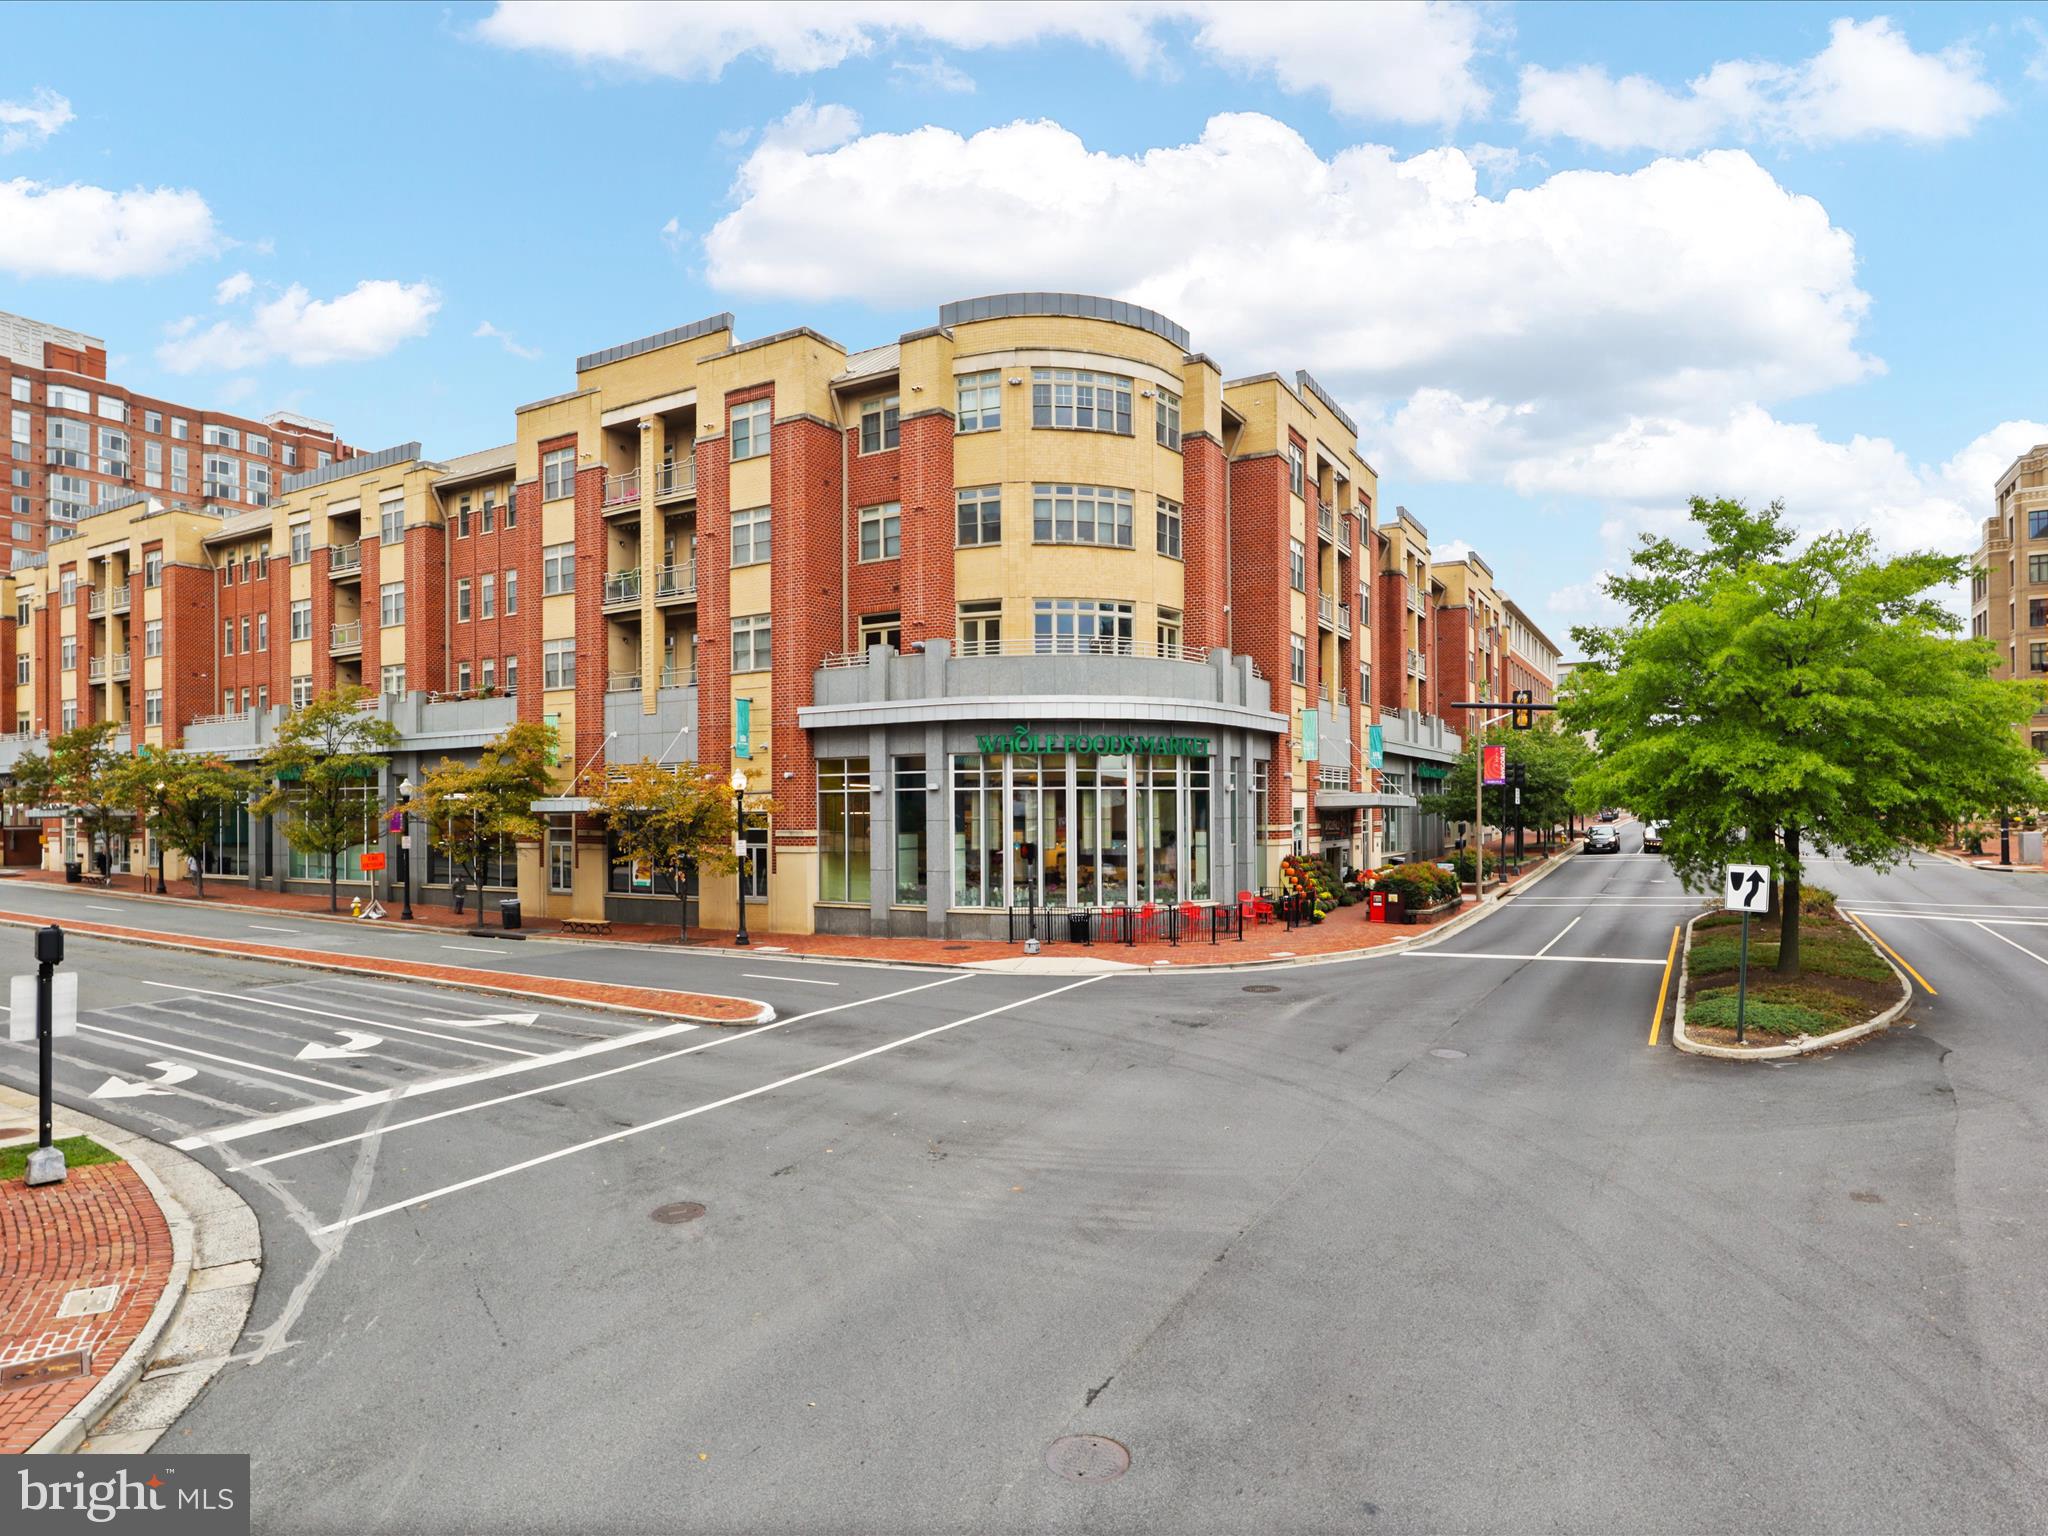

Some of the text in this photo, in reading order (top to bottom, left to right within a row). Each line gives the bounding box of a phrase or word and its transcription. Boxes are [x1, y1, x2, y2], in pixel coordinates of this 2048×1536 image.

[976, 727, 1211, 755] WHOLE FOODS MARKET
